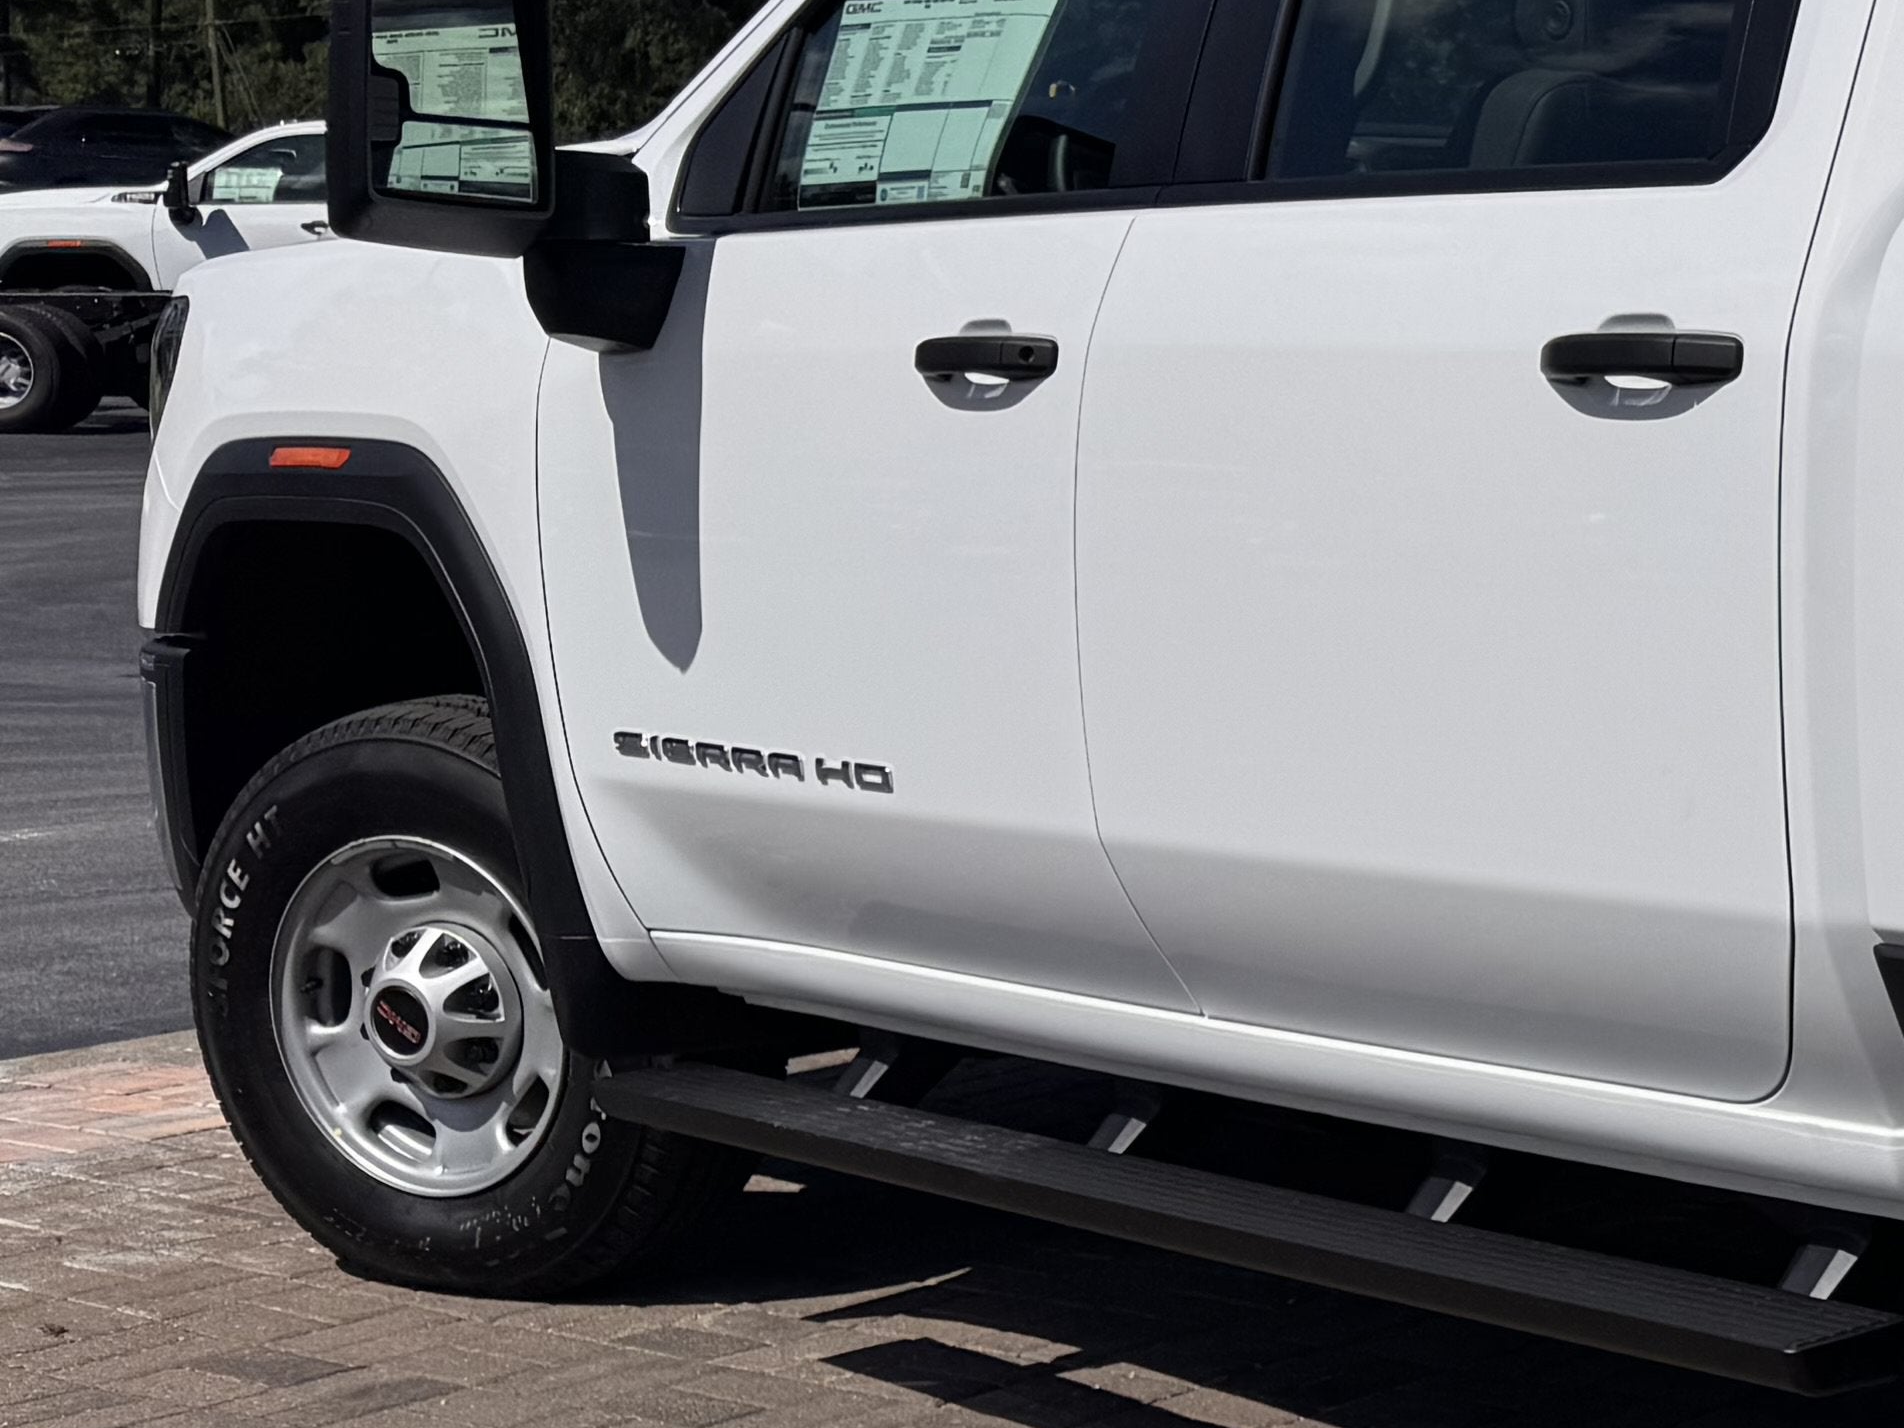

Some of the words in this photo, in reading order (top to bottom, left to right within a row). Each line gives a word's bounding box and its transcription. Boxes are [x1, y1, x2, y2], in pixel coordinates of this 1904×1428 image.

[846, 1, 884, 15] GMC
[613, 731, 806, 782] SIERRA
[815, 757, 894, 794] HD
